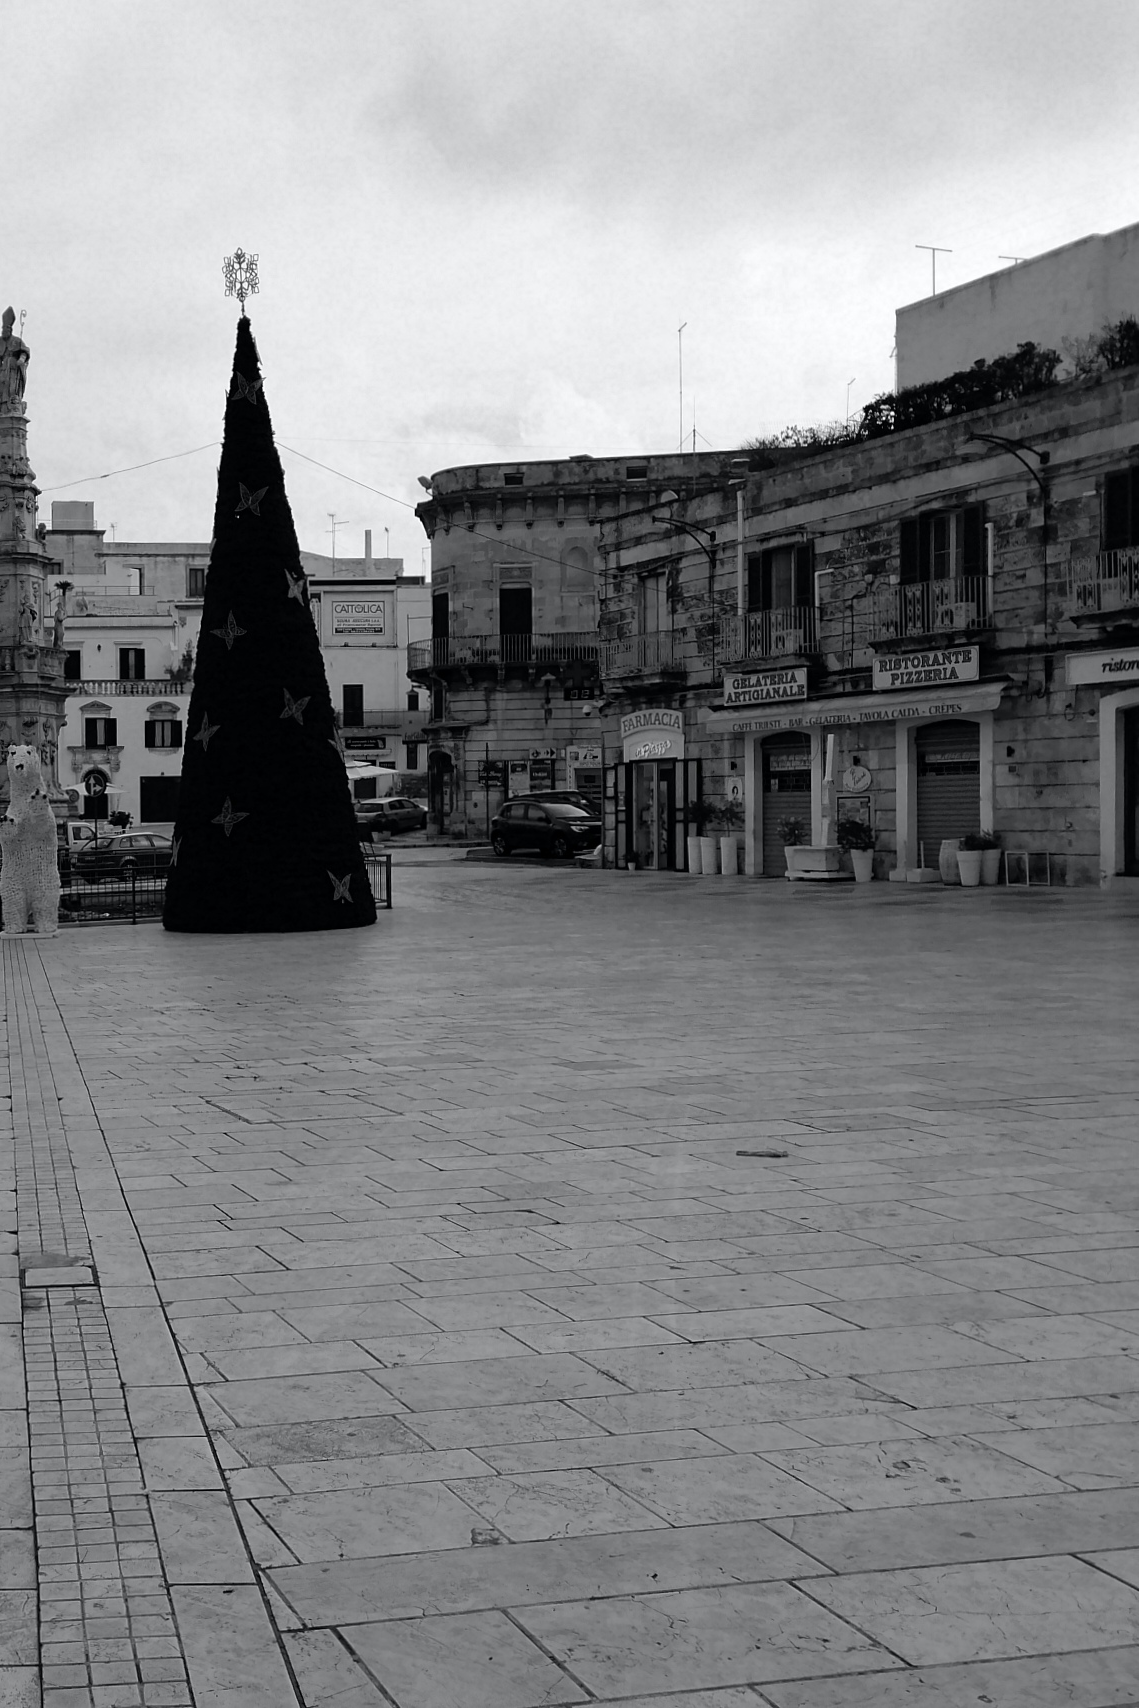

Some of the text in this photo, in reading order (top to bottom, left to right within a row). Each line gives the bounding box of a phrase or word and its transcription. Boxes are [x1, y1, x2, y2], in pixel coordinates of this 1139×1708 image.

[335, 604, 383, 614] CATTOLICA
[879, 650, 971, 673] RISTORANTE
[732, 671, 797, 690] GELATERIA
[891, 667, 959, 686] PIZZERIA
[726, 684, 804, 704] ARTIGIANALE
[622, 713, 681, 733] FARMACIA
[789, 717, 805, 727] BAR
[809, 714, 851, 725] GELATERIA
[859, 710, 889, 722] TAVOLA
[891, 707, 920, 719] CALDA
